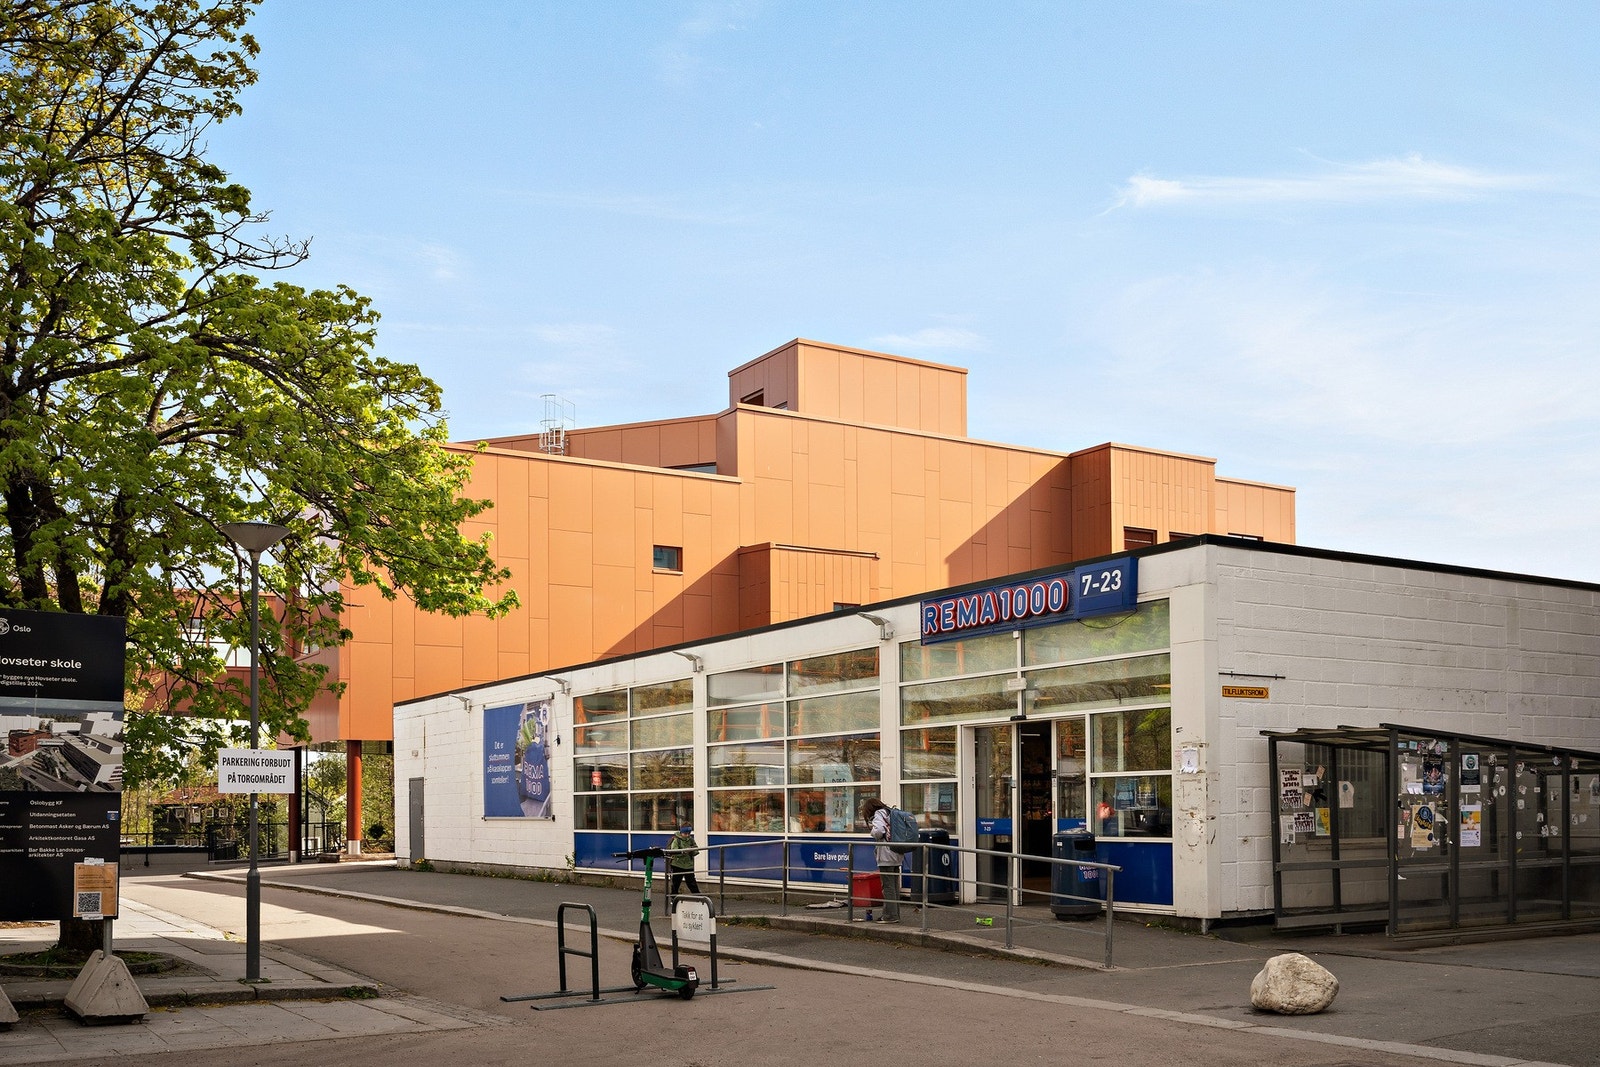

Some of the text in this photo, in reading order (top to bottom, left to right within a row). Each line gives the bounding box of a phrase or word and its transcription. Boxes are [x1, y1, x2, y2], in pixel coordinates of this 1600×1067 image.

[1082, 569, 1123, 597] 7-23
[13, 624, 31, 633] Oslo
[0, 656, 82, 669] ovseter skole
[1223, 688, 1264, 697] TILFLUKTSROM
[222, 757, 291, 768] PARKERING FORBUDT
[227, 772, 286, 784] PÅ TORGOMRÅDET
[814, 852, 826, 861] Bare
[827, 853, 837, 861] lave
